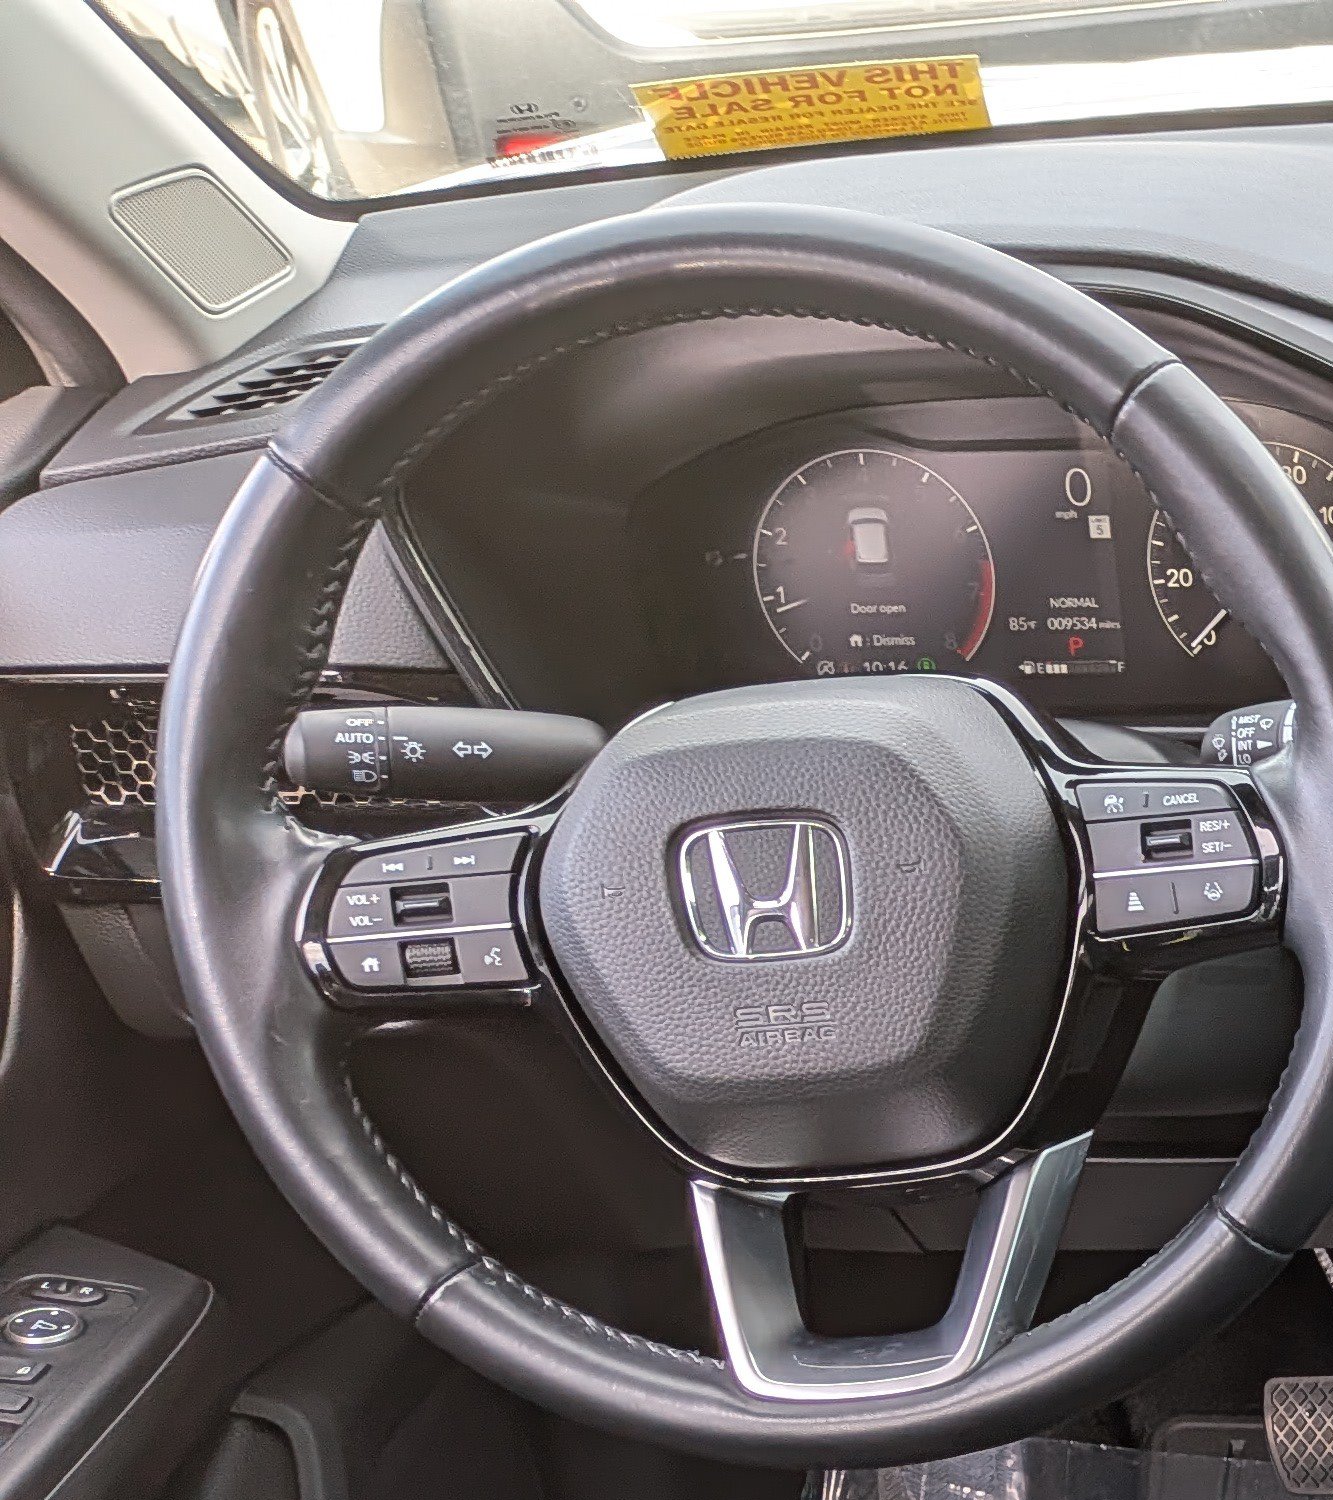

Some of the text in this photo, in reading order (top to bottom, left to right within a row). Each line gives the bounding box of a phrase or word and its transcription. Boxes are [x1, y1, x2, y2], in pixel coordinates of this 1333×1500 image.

[1065, 467, 1092, 507] 0
[775, 527, 788, 545] 2
[1166, 568, 1193, 587] 20
[850, 603, 907, 615] Door open
[1049, 597, 1099, 609] NORMAL
[1046, 616, 1097, 631] 009534
[873, 634, 916, 647] Dismiss
[1068, 636, 1085, 657] P
[346, 718, 374, 727] OFF
[335, 732, 374, 744] AUTO
[1236, 727, 1256, 739] OFF
[1237, 740, 1253, 751] INT
[1238, 753, 1252, 764] LO
[1162, 792, 1200, 806] CANCEL
[346, 893, 380, 906] VOL+
[734, 1001, 832, 1026] SRS
[737, 1025, 837, 1047] AIRBAG
